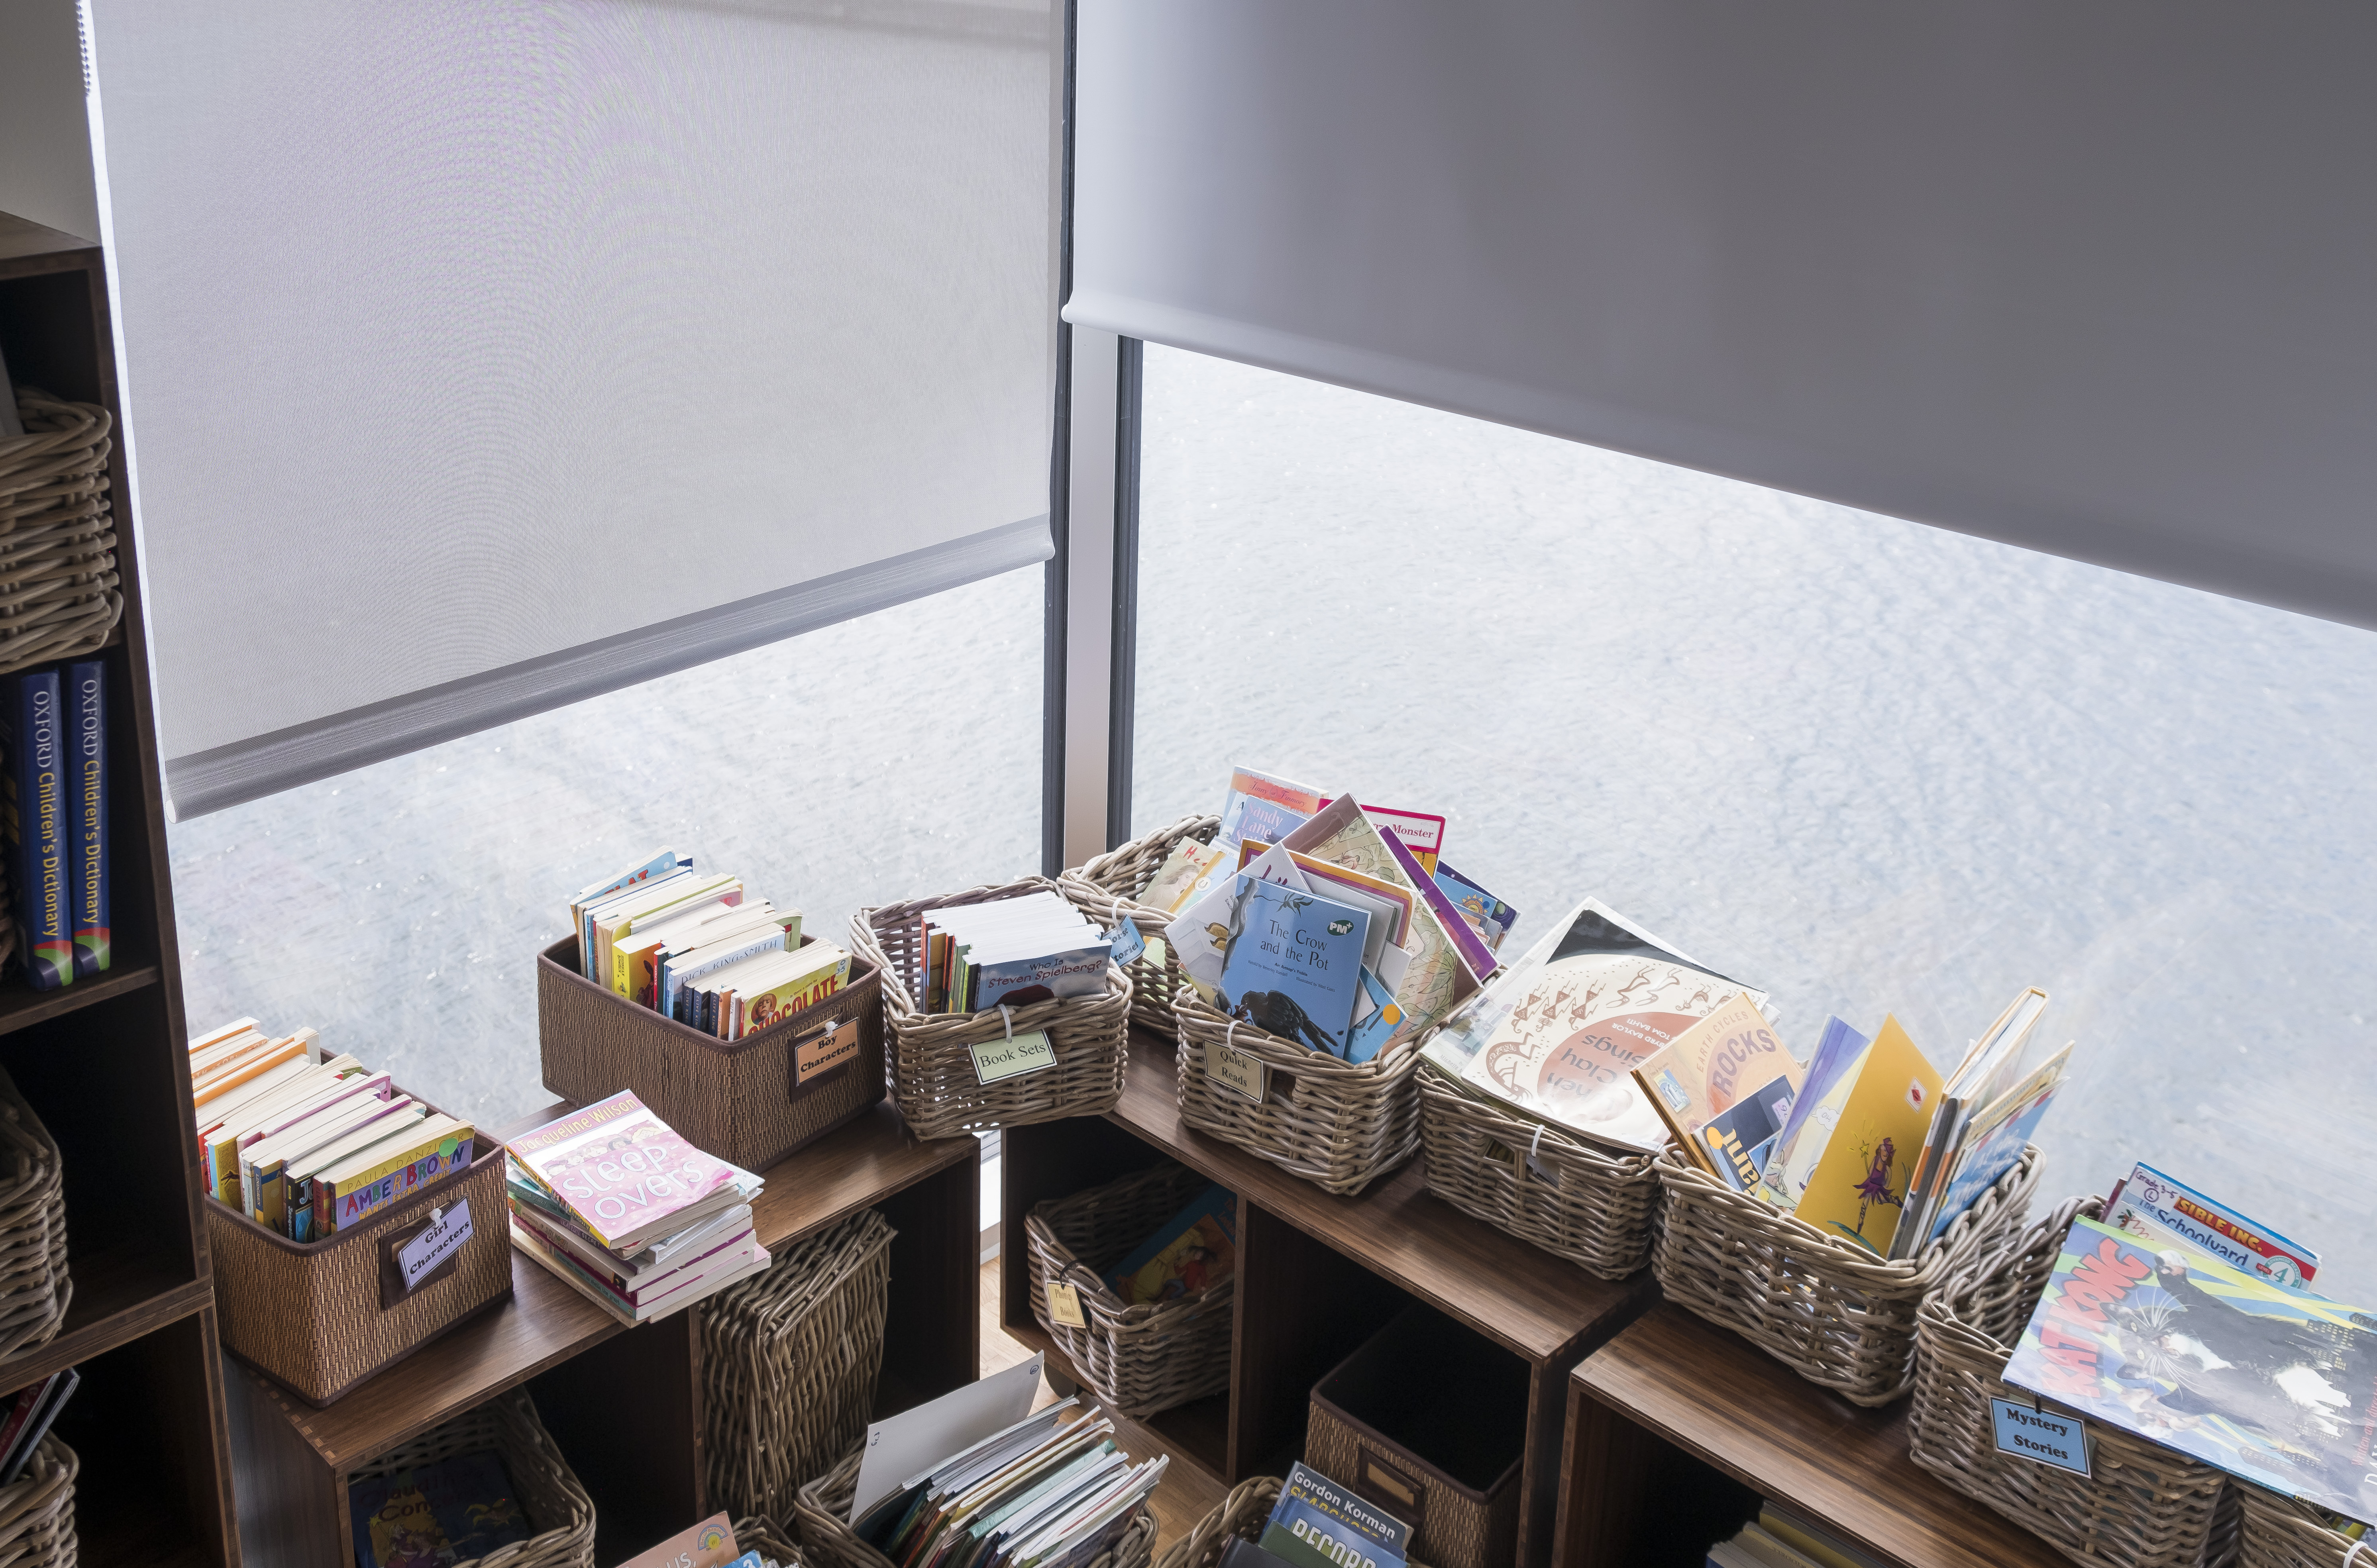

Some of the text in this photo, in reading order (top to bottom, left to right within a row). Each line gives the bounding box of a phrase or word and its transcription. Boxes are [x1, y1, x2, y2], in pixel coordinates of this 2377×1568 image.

[33, 691, 59, 936] OXFORD Children's Dictionary
[81, 679, 101, 924] OXFORD Children's Dictionary
[1247, 801, 1284, 830] Sandy
[1242, 816, 1272, 840] Lane
[1392, 824, 1434, 838] Monster
[1110, 928, 1129, 943] orse
[1270, 919, 1327, 951] The Crow
[1029, 958, 1064, 971] Who Is
[1114, 941, 1138, 962] tories
[1260, 940, 1329, 971] and the Pot
[988, 960, 1102, 989] Steven Spielberg?
[817, 1035, 838, 1050] Boy
[1611, 1022, 1643, 1040] BAYLOR
[1652, 1028, 1671, 1040] TOM
[1696, 1010, 1749, 1073] EARTH CYCLES
[800, 1040, 856, 1073] Characters
[979, 1042, 1047, 1068] Book Sets
[1220, 1051, 1248, 1070] Quick
[1560, 1048, 1617, 1084] Clay
[1713, 1028, 1777, 1098] ROCKS
[1221, 1066, 1247, 1087] Reads
[514, 1098, 639, 1153] Jacqueline Wilson
[347, 1167, 389, 1193] PAULA
[396, 1133, 464, 1169] DANZIR
[346, 1174, 402, 1217] AMBER
[406, 1146, 465, 1186] BROWN
[359, 1197, 389, 1220] WANTS
[392, 1183, 419, 1203] EXTRA
[423, 1168, 452, 1188] CREDIT
[2161, 1185, 2179, 1199] 3-5
[425, 1220, 449, 1244] Girl
[2179, 1199, 2263, 1253] SIBLE INC.
[409, 1221, 470, 1275] Characters
[2273, 1268, 2289, 1283] 4
[2038, 1238, 2151, 1399] KAT KONG
[2005, 1407, 2069, 1437] Mystery
[2014, 1435, 2069, 1460] Stories
[1294, 1471, 1341, 1507] Gordon
[1344, 1499, 1396, 1539] Korman
